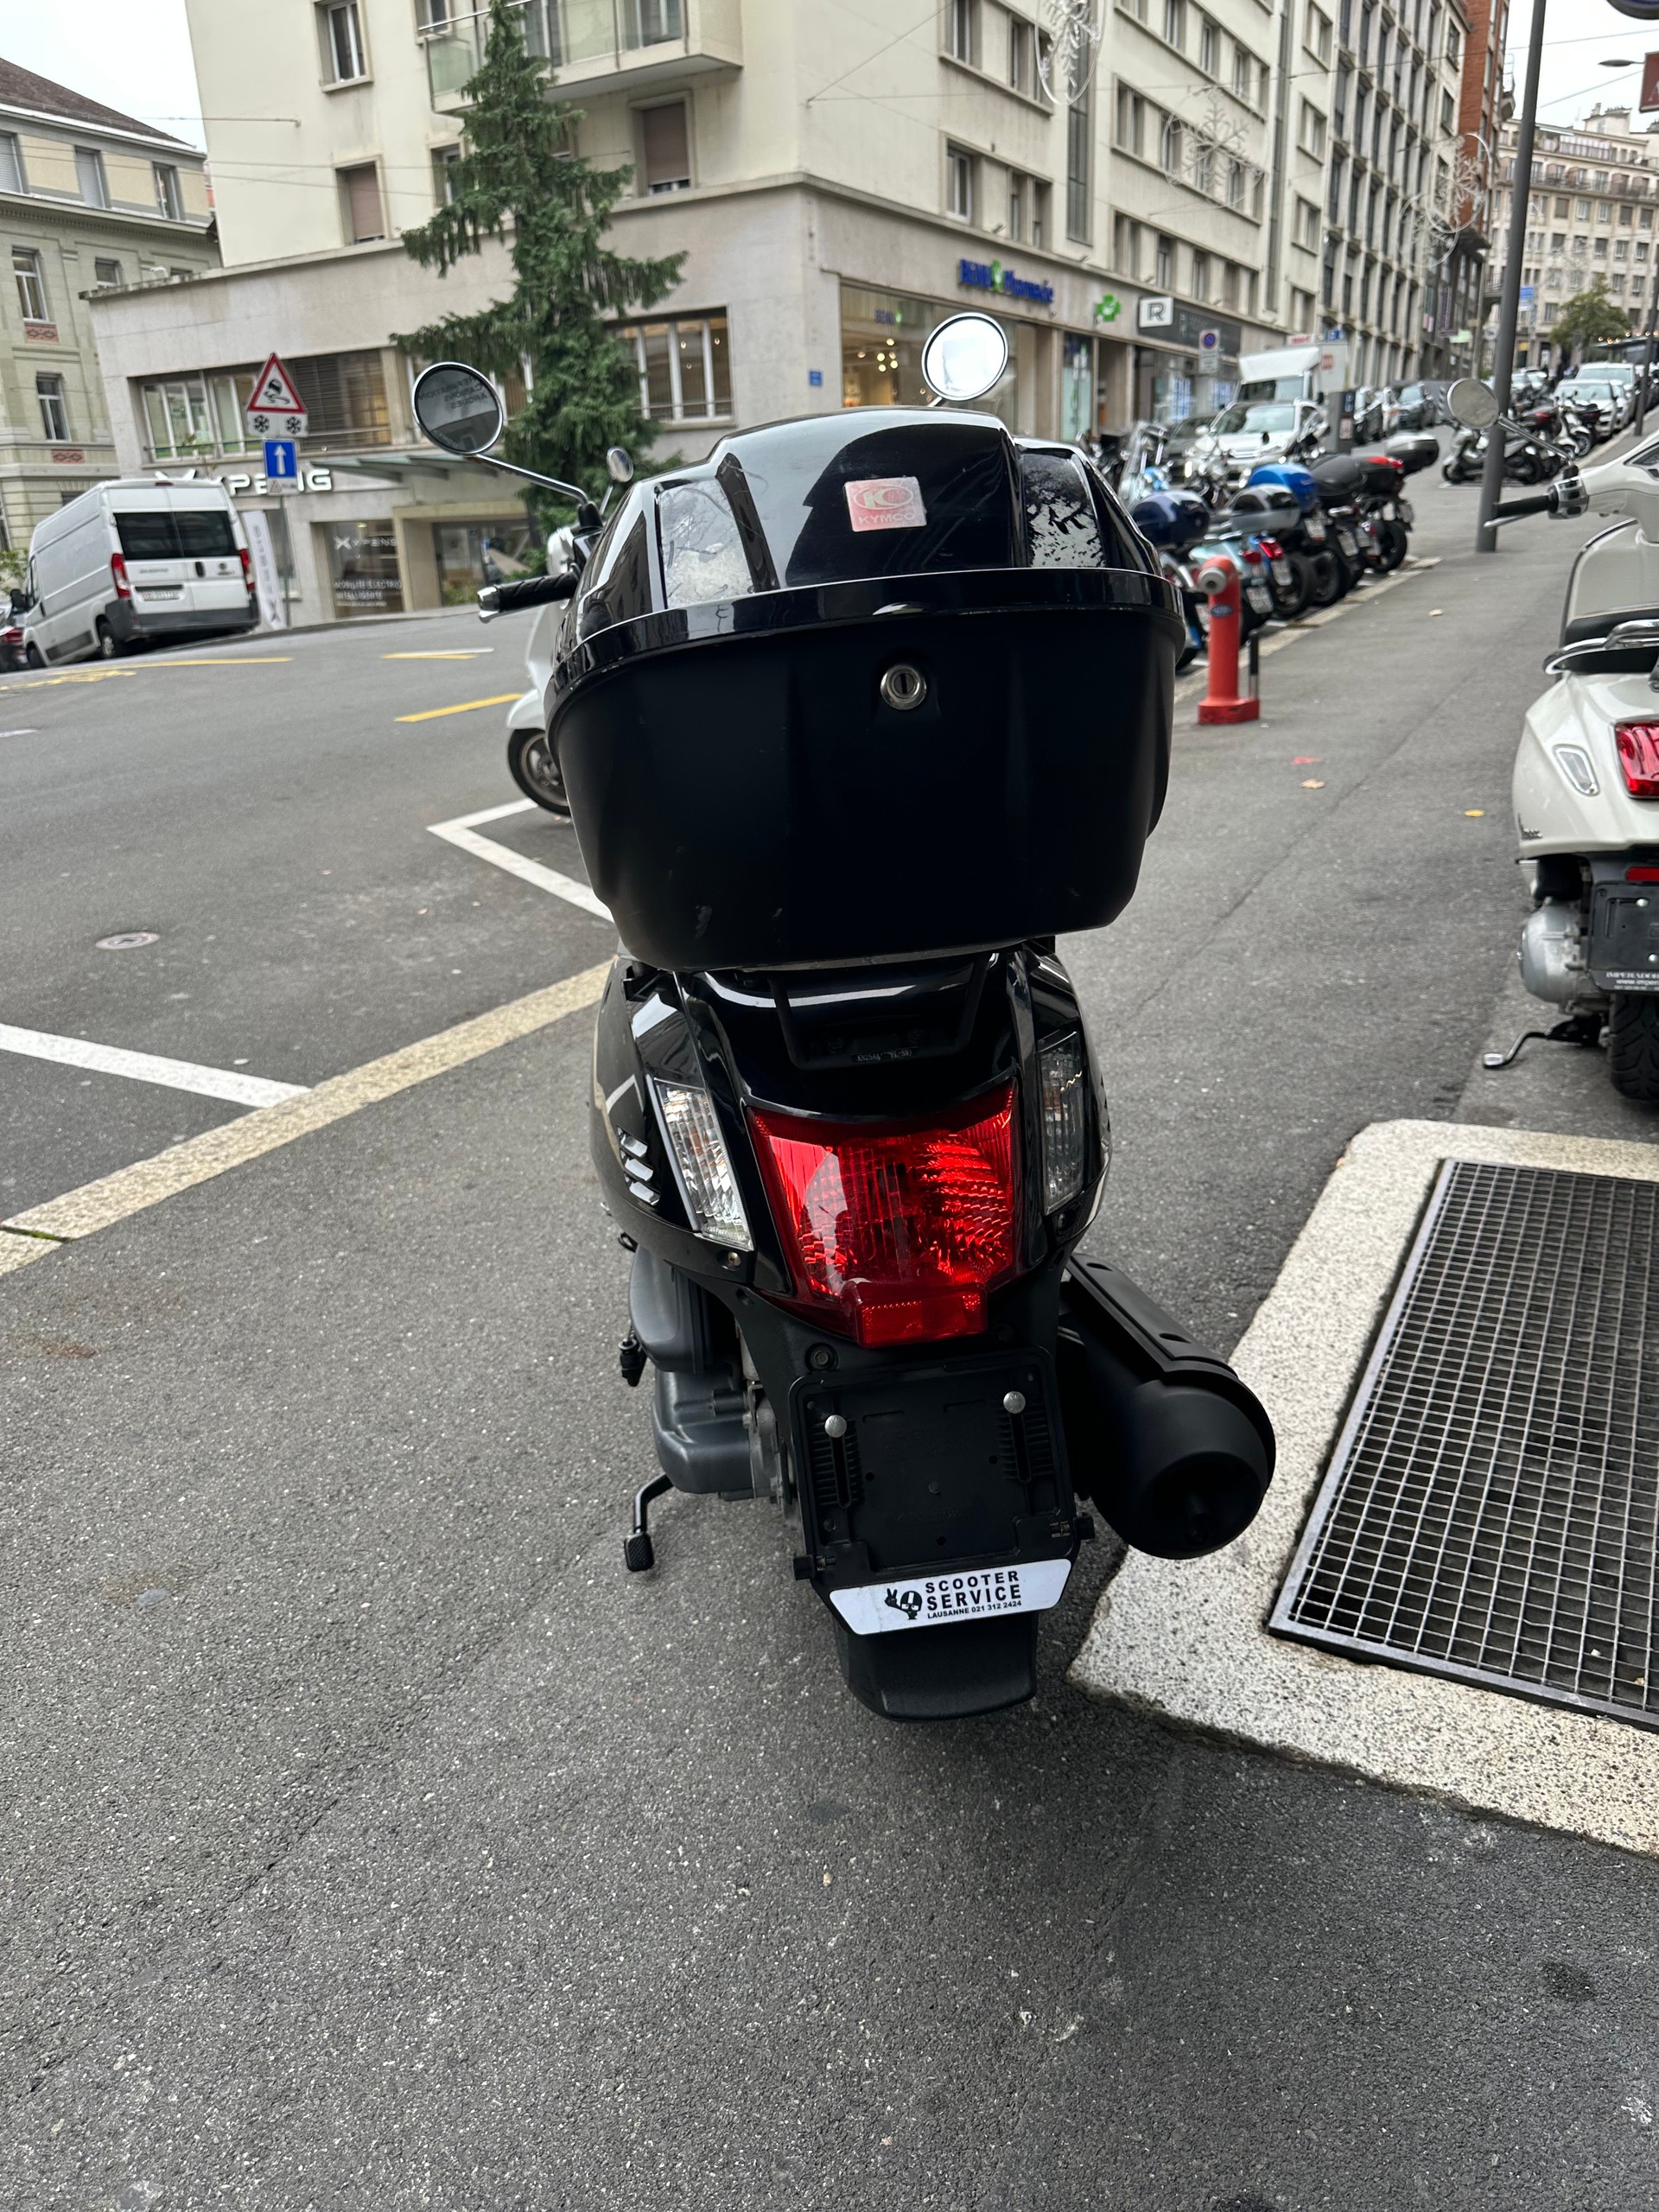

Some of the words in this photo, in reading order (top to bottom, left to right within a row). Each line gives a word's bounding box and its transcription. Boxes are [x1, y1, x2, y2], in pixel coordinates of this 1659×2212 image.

[859, 512, 915, 525] KYMCO
[925, 1571, 1019, 1593] SCOOTER
[927, 1584, 1021, 1611] SERVICE
[927, 1607, 969, 1619] LAUSANNE
[971, 1605, 985, 1613] 021
[988, 1602, 1001, 1611] 312
[1003, 1599, 1022, 1608] 2424
